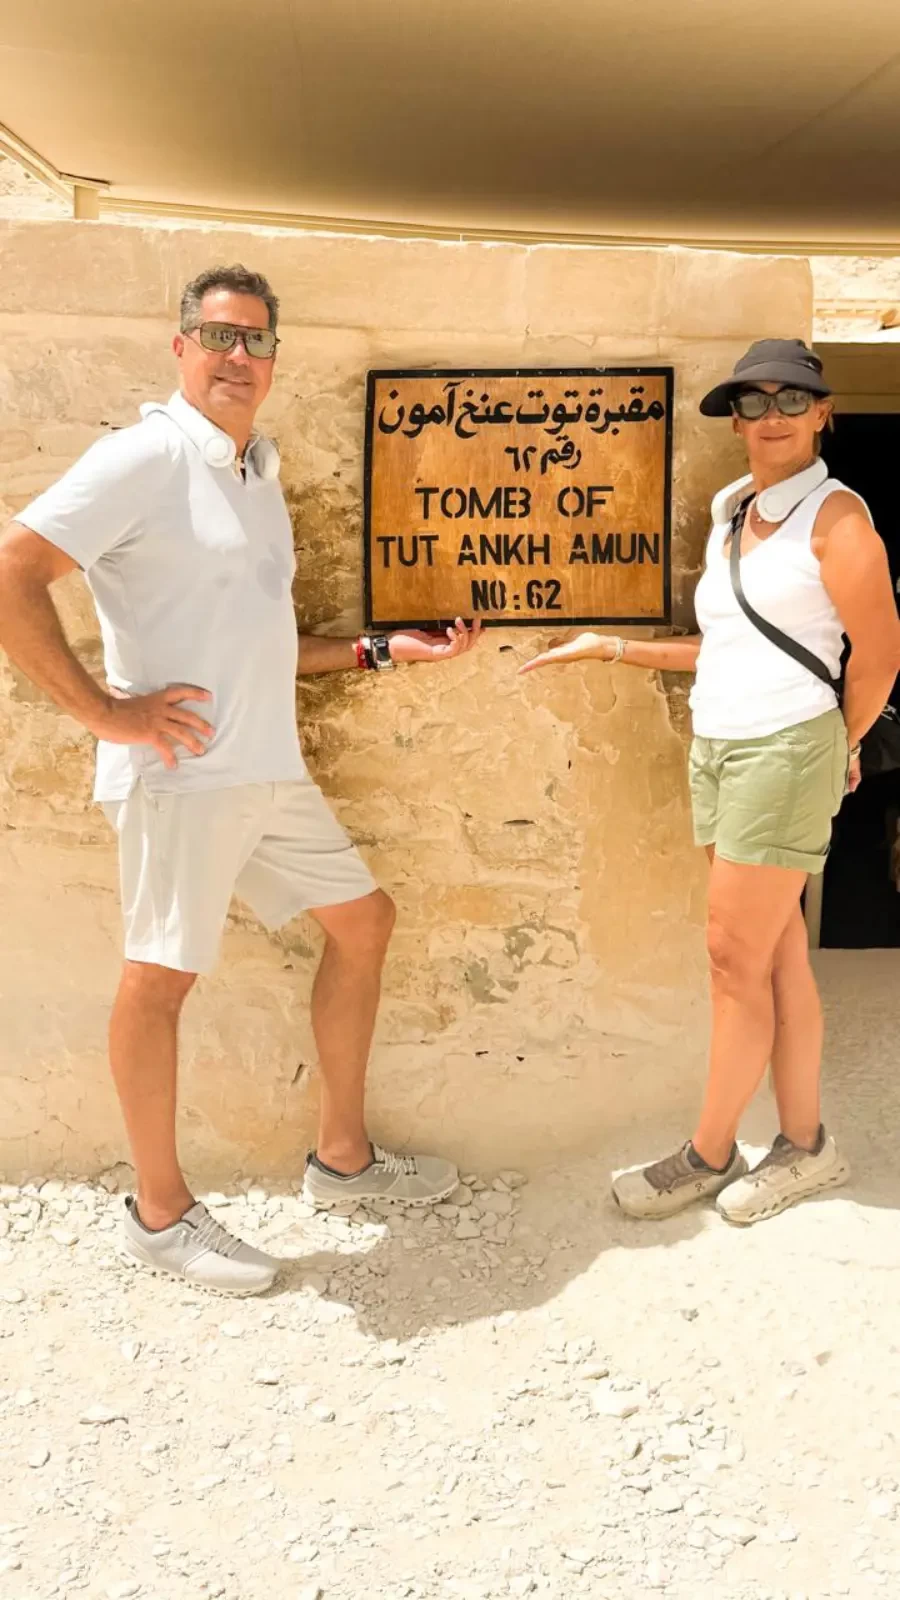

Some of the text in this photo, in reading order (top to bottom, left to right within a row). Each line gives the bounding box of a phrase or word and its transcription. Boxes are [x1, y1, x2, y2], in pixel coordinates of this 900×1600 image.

[377, 380, 665, 439] مقبرة توت عنخ آمون
[504, 434, 582, 475] رقم ٦٢
[414, 485, 614, 520] TOMB OF
[376, 532, 660, 568] TUT ANKH AMUN
